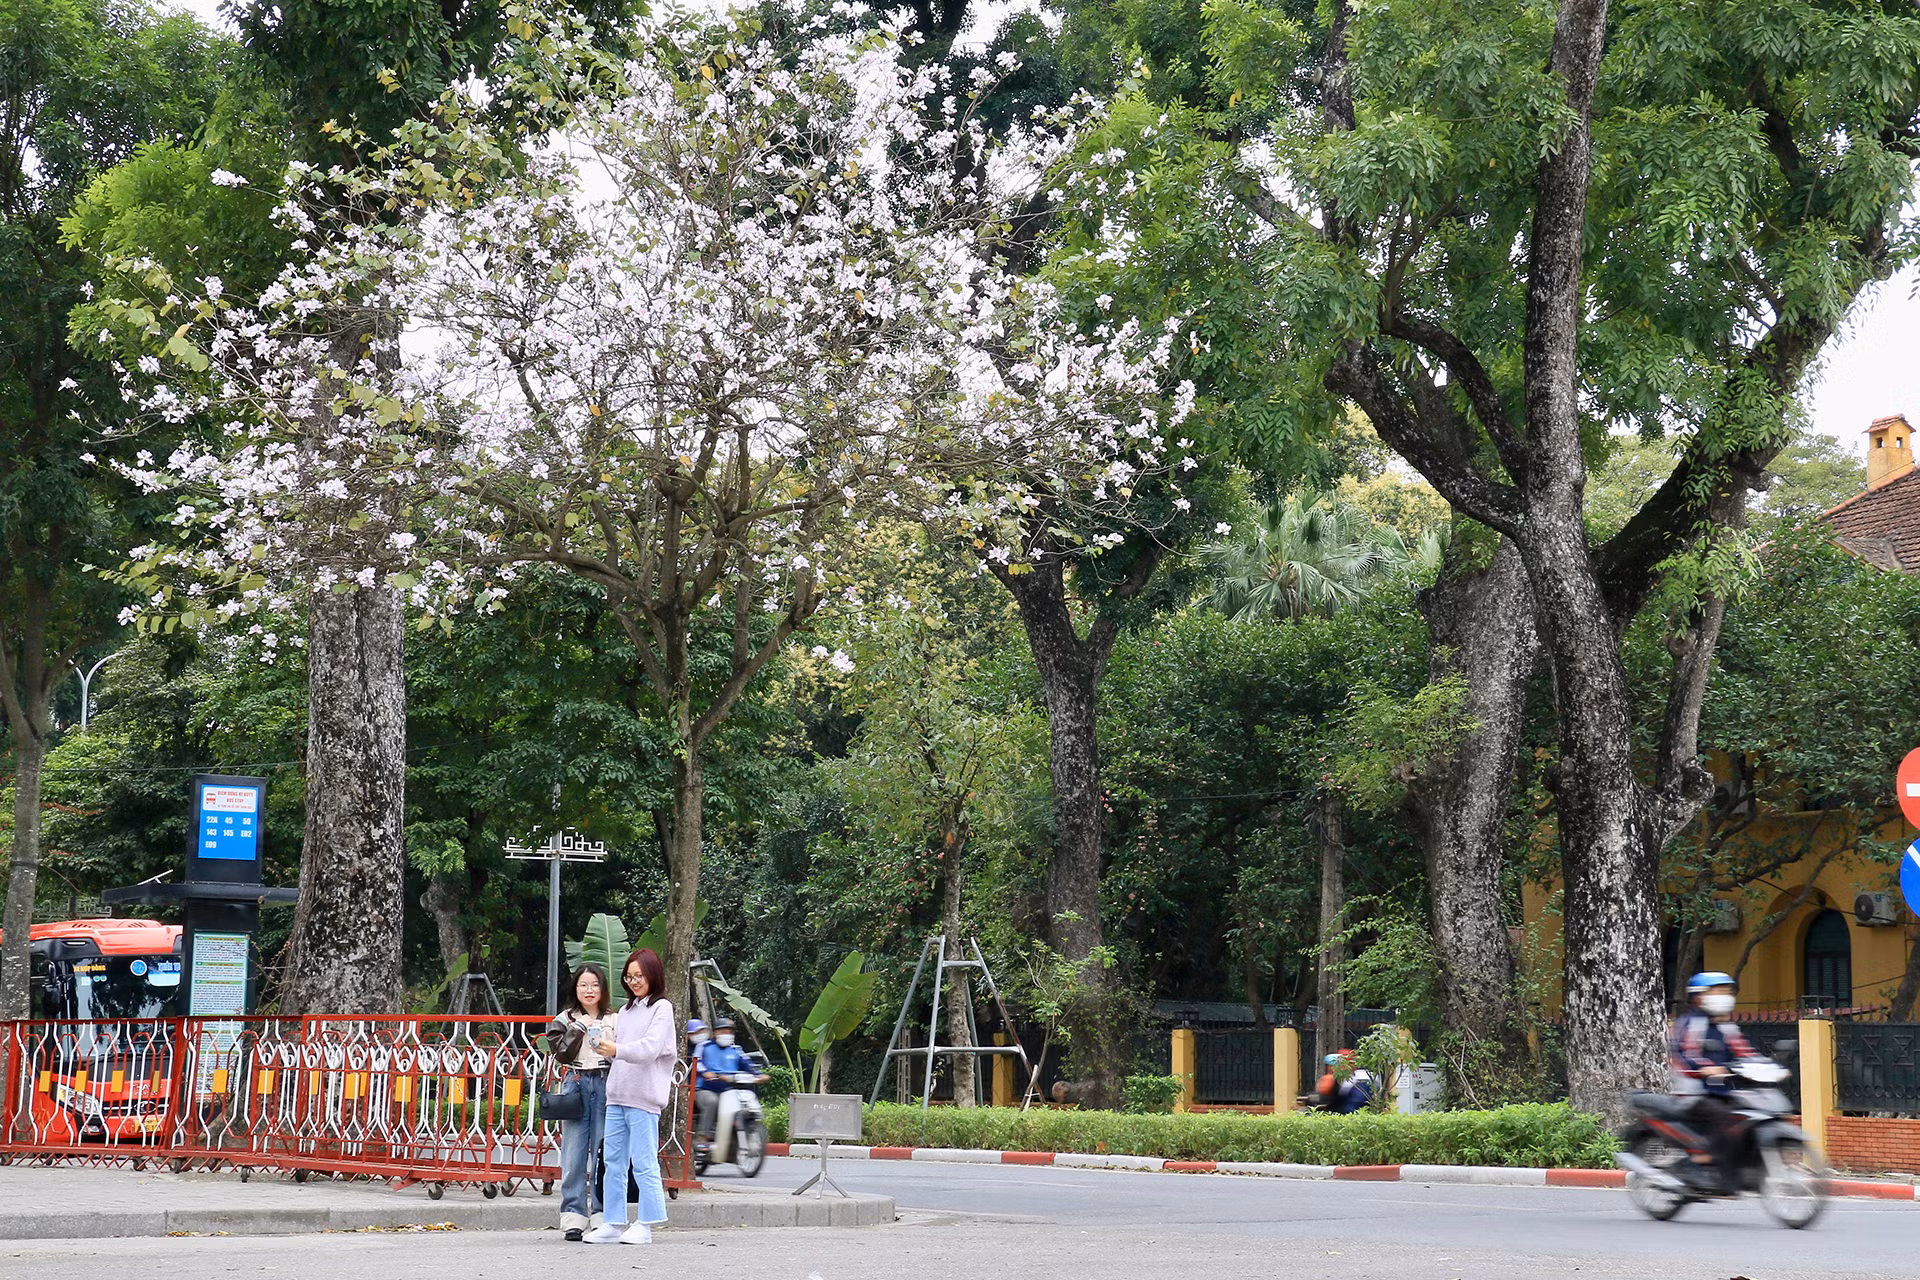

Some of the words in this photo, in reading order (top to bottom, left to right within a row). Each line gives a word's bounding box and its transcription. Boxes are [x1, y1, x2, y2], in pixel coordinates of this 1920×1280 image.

[206, 816, 218, 824] 22A
[225, 817, 233, 825] 45
[223, 829, 234, 837] 145
[240, 830, 252, 838] E02
